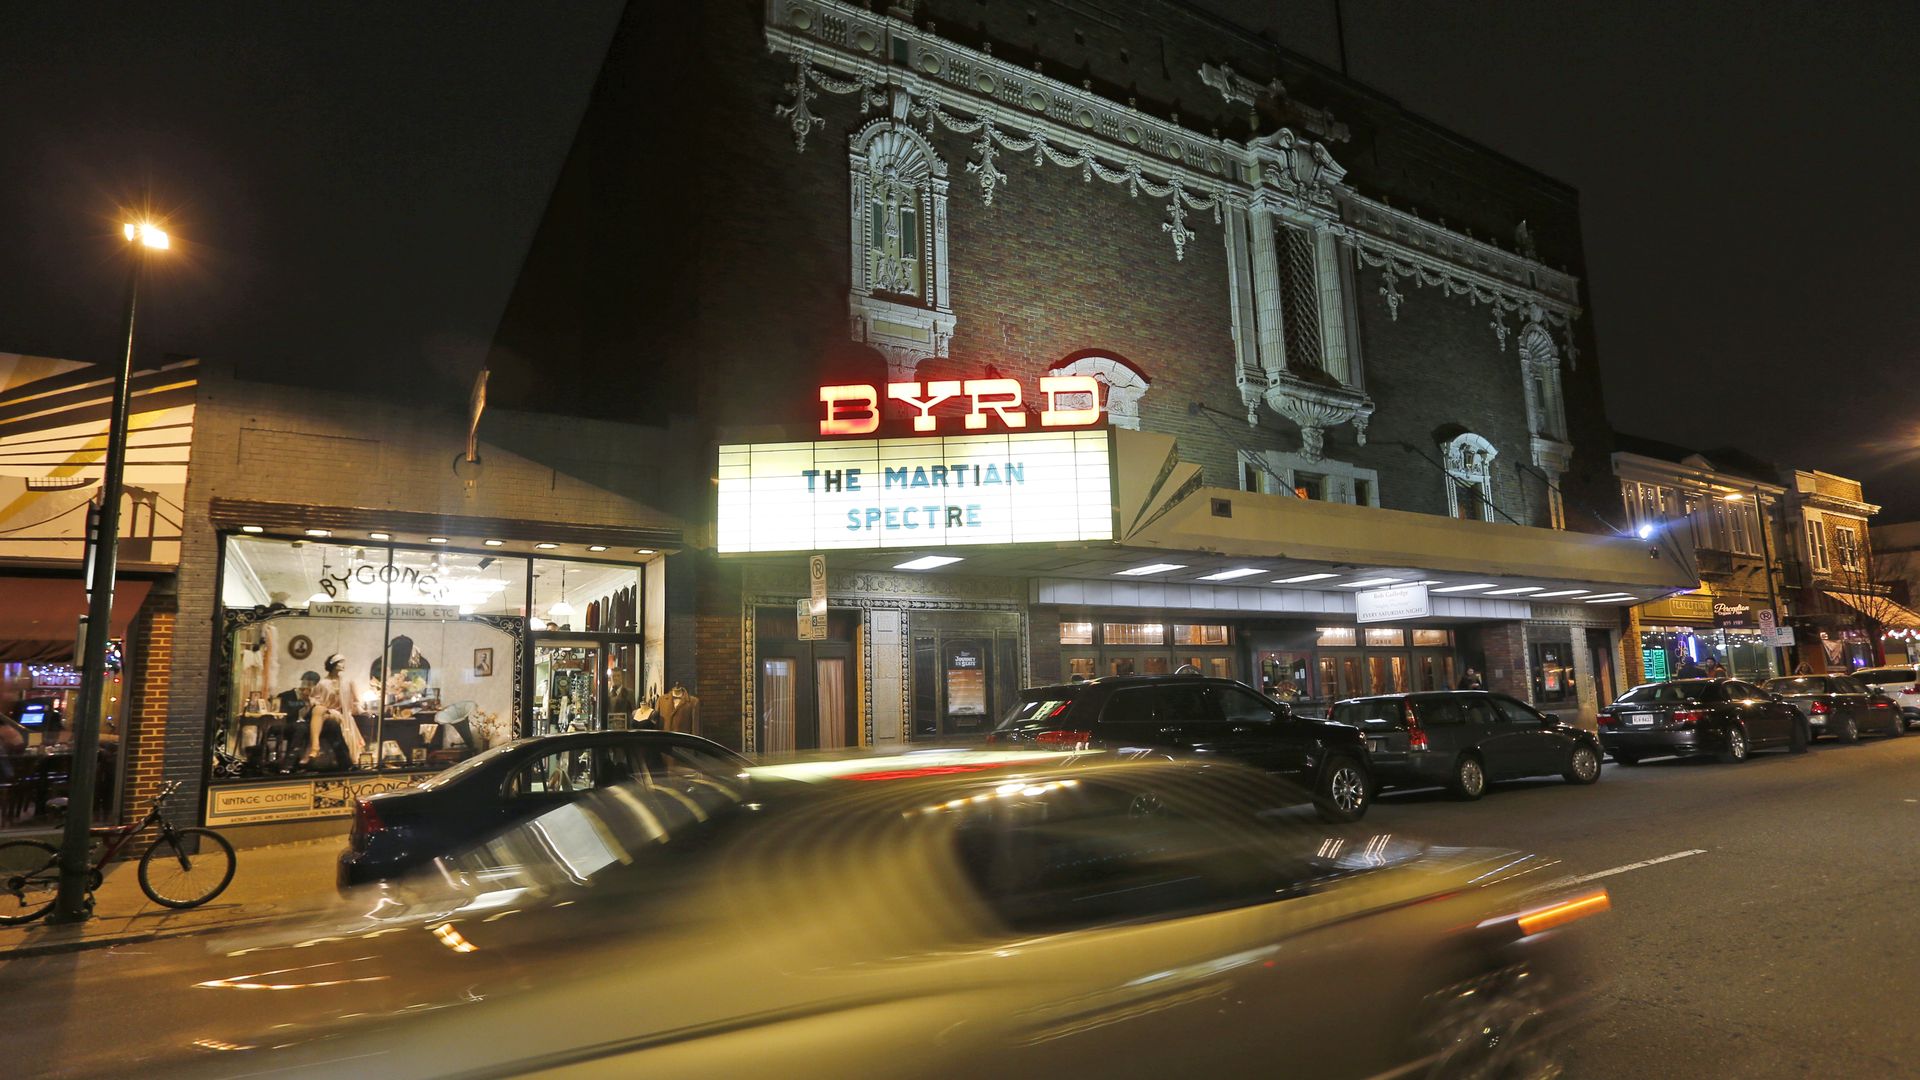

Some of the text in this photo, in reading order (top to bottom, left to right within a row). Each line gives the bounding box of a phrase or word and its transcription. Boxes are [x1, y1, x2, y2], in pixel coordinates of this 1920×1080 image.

[820, 376, 1101, 435] BYRD
[802, 462, 1025, 493] THE MARTIAN
[846, 504, 982, 531] SPECTRE
[315, 604, 363, 617] VINTAGE
[370, 607, 426, 618] CLOTHING
[553, 651, 578, 661] 2916
[222, 781, 412, 806] VINTAGE CLOTHING BYGON
